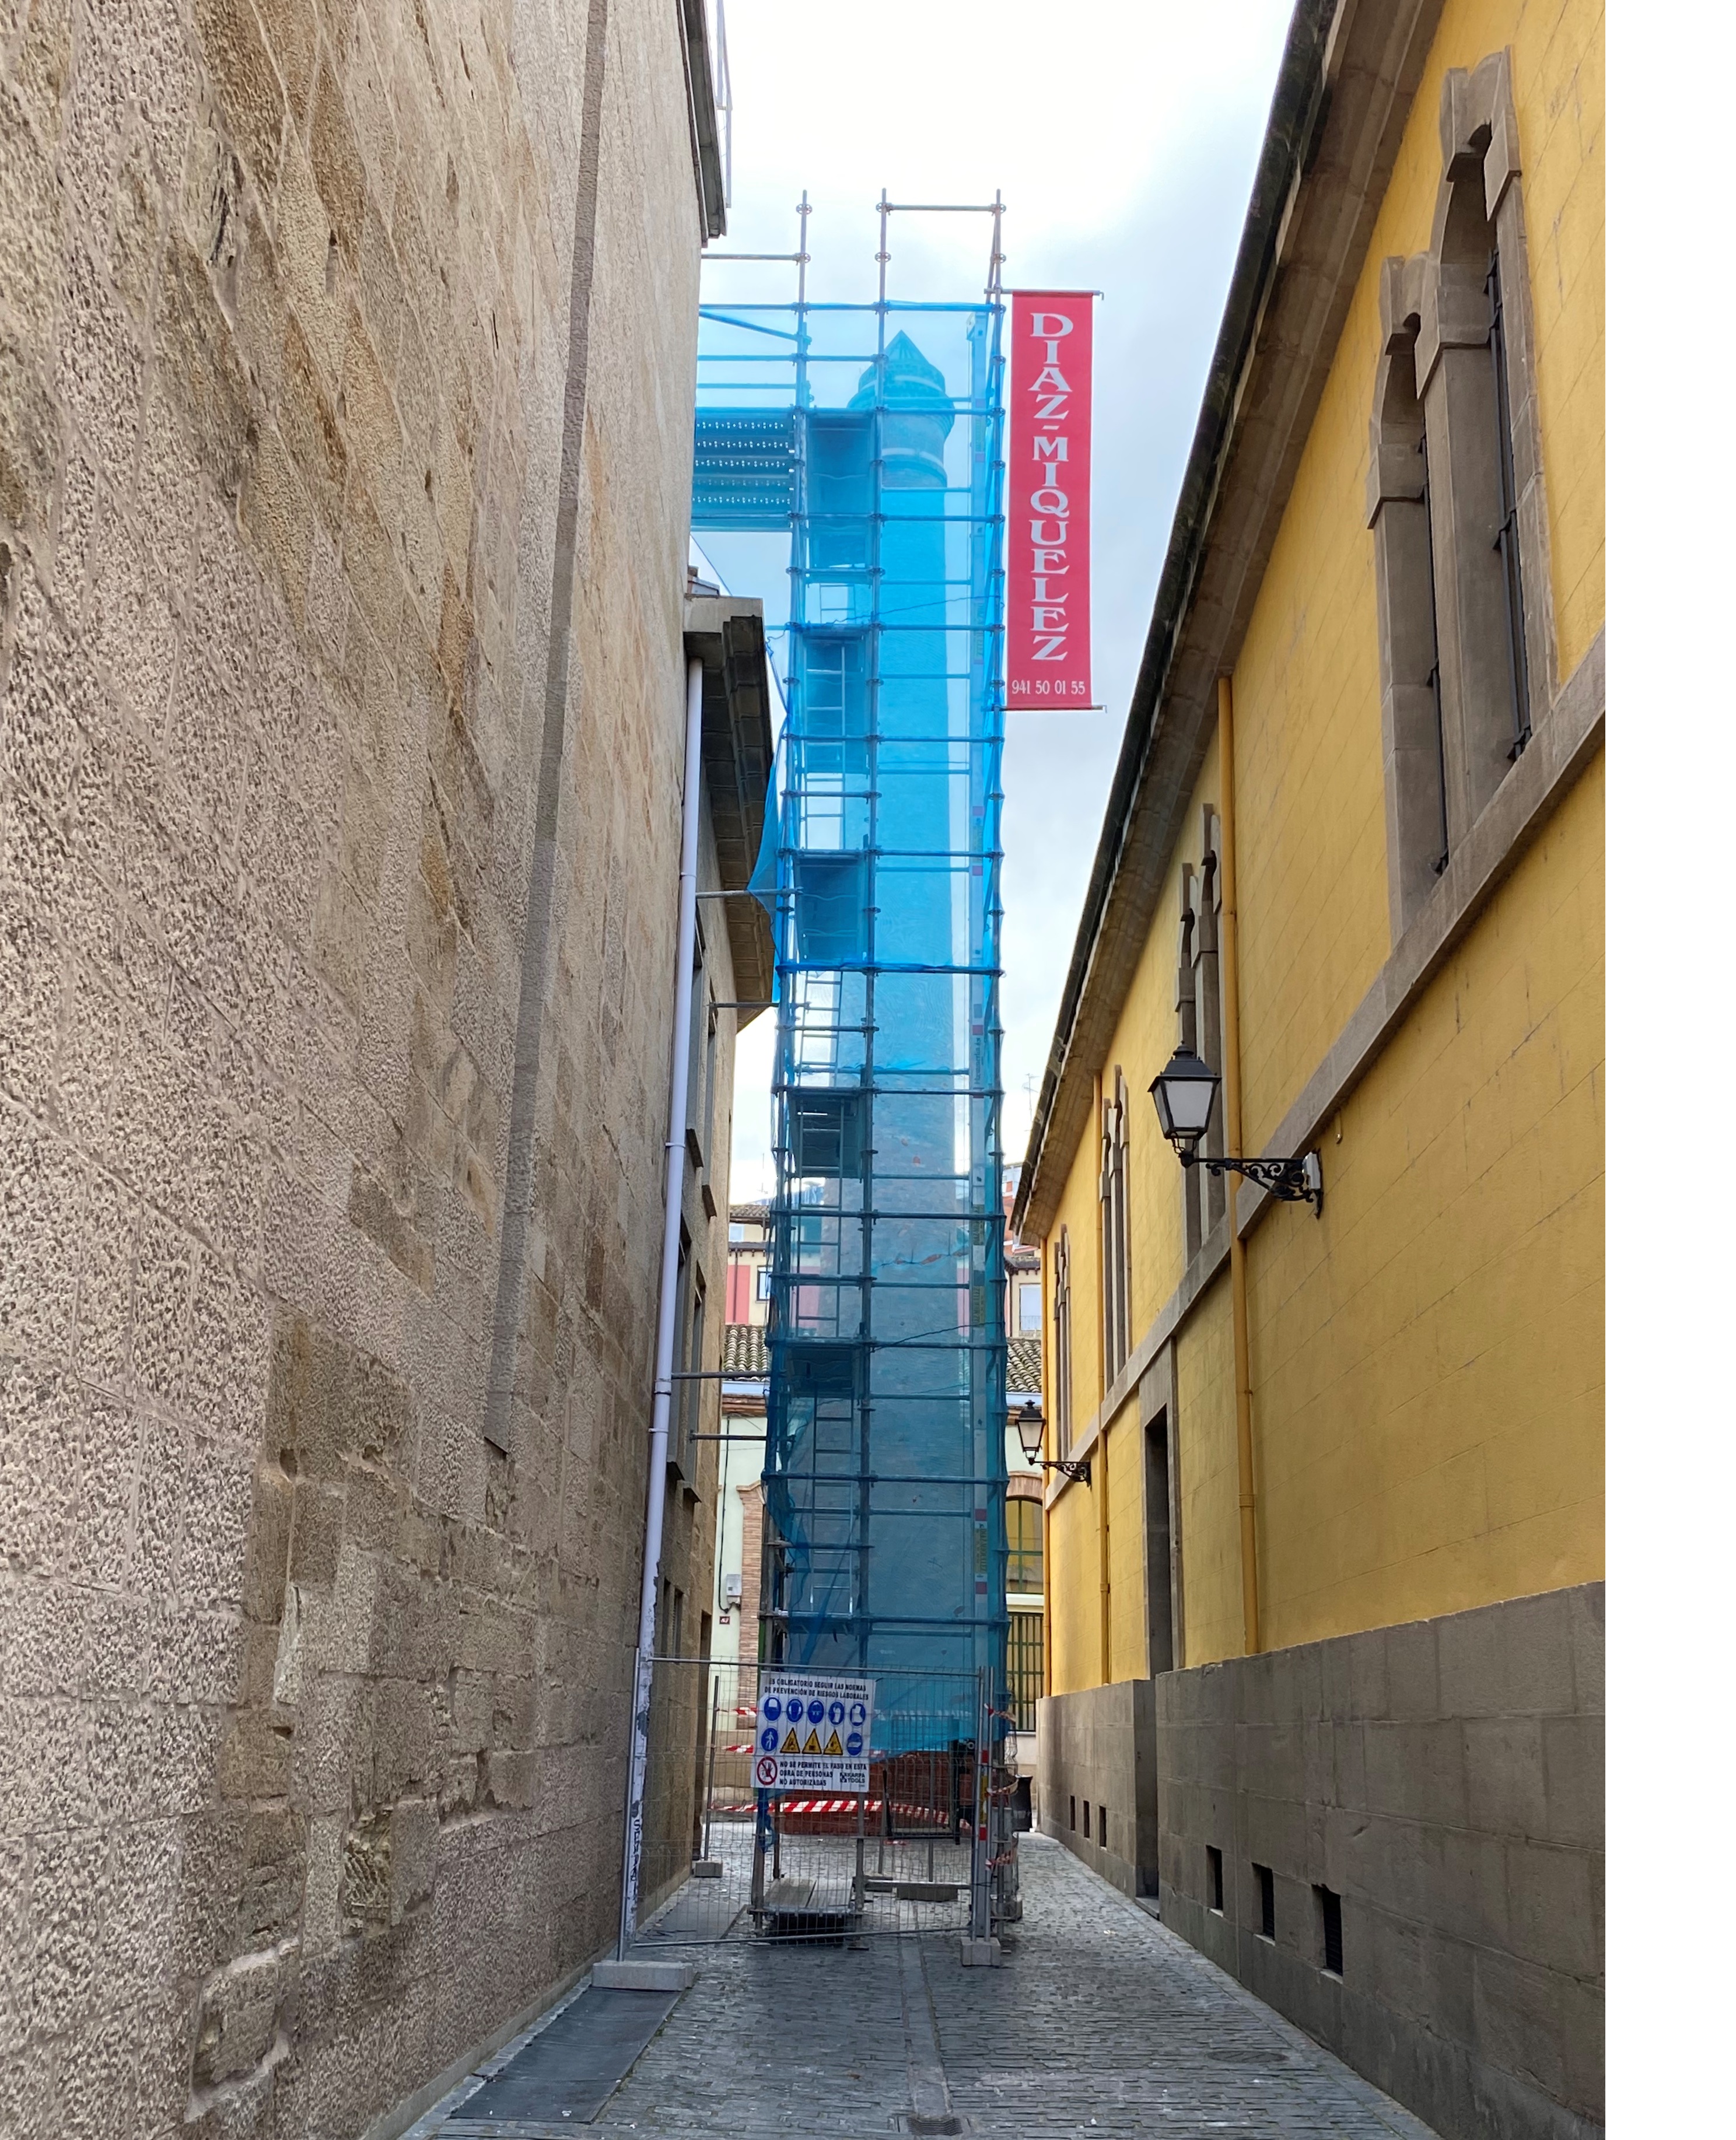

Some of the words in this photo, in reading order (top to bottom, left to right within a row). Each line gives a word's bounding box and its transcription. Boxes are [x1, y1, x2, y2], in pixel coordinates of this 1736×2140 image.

[1028, 313, 1073, 660] DIAZ-MIQUELEZ
[1012, 680, 1031, 695] 941
[1035, 680, 1050, 695] 50
[1054, 680, 1066, 695] 01
[1070, 681, 1085, 695] 55
[777, 1679, 813, 1687] OBLIGATORIO
[773, 1687, 807, 1696] PREVENCIÓN
[840, 1692, 869, 1700] LABORALES
